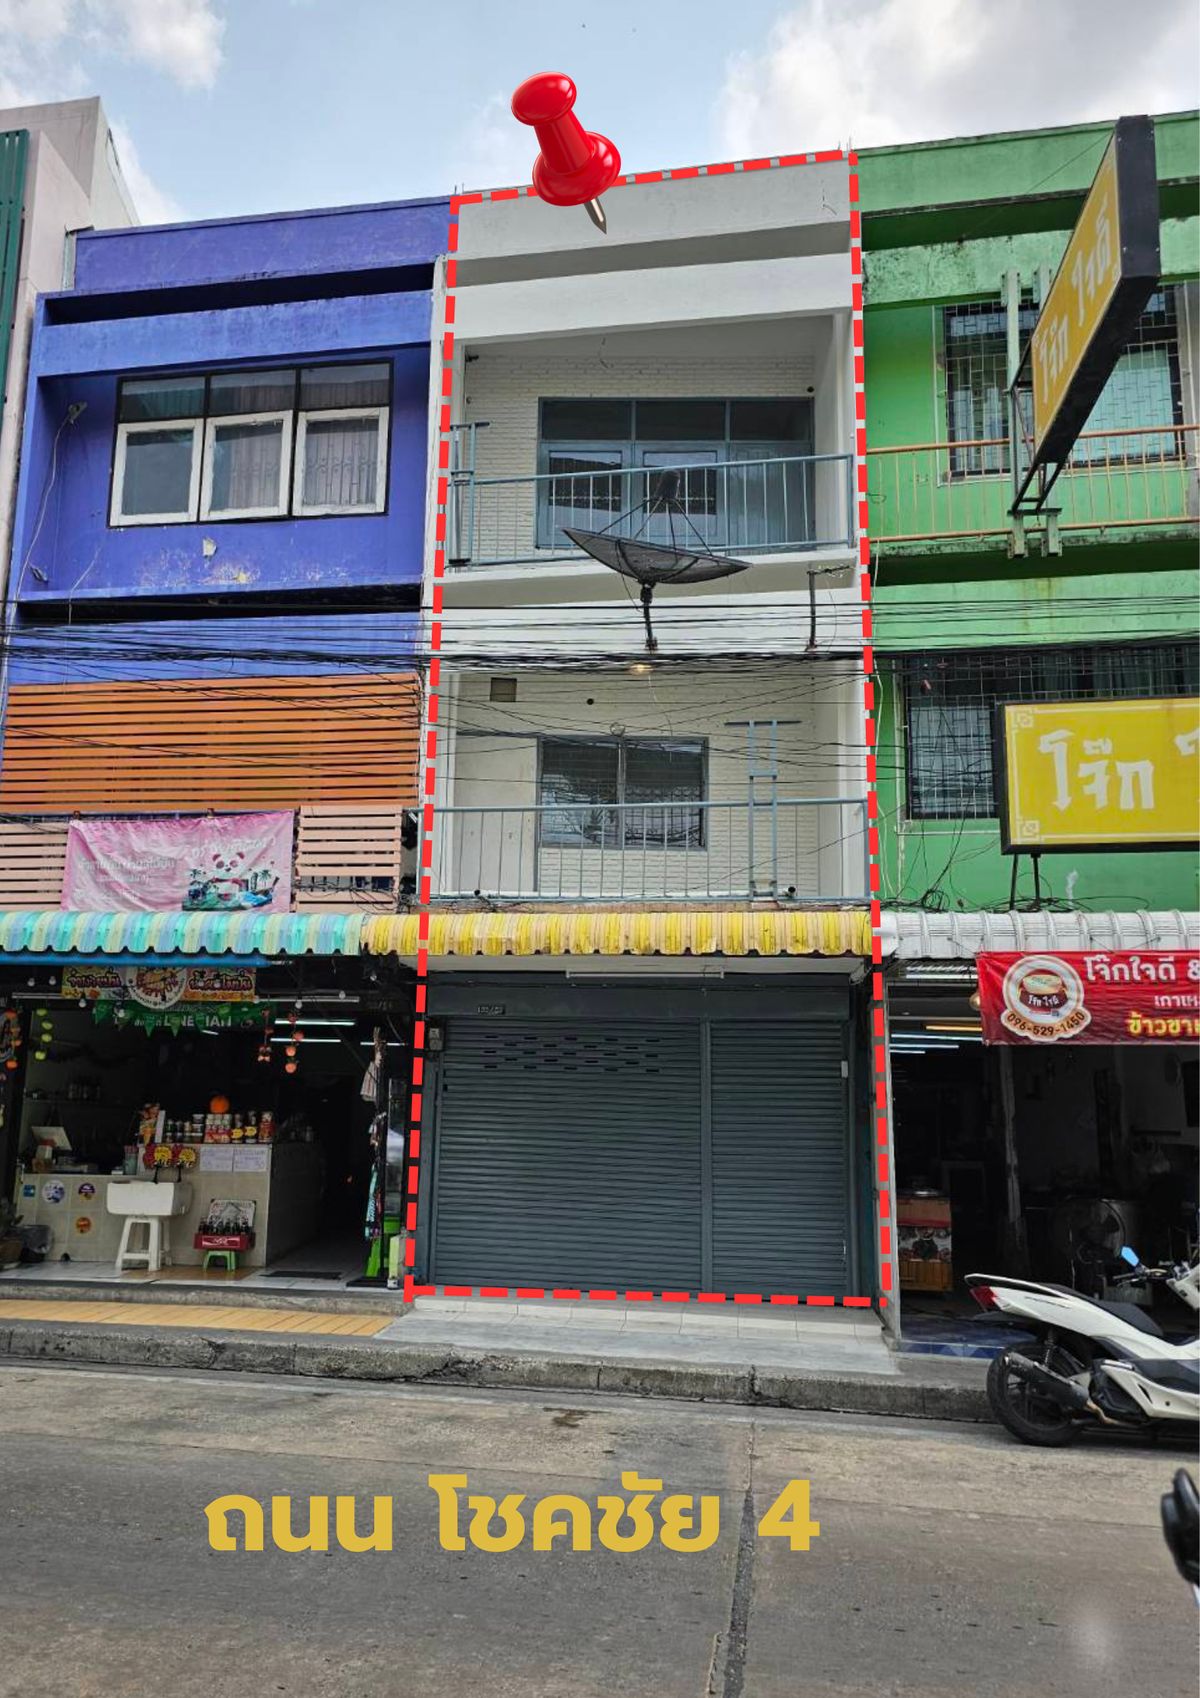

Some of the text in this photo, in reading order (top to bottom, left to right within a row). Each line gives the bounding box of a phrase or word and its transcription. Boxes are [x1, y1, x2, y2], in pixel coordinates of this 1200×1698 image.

[1038, 728, 1156, 812] โจ๊ก
[1083, 953, 1176, 982] โจ๊กใจดี
[1154, 994, 1200, 1008] เกาเห
[164, 1015, 195, 1027] LNE
[1007, 1010, 1085, 1037] 096-529-1450
